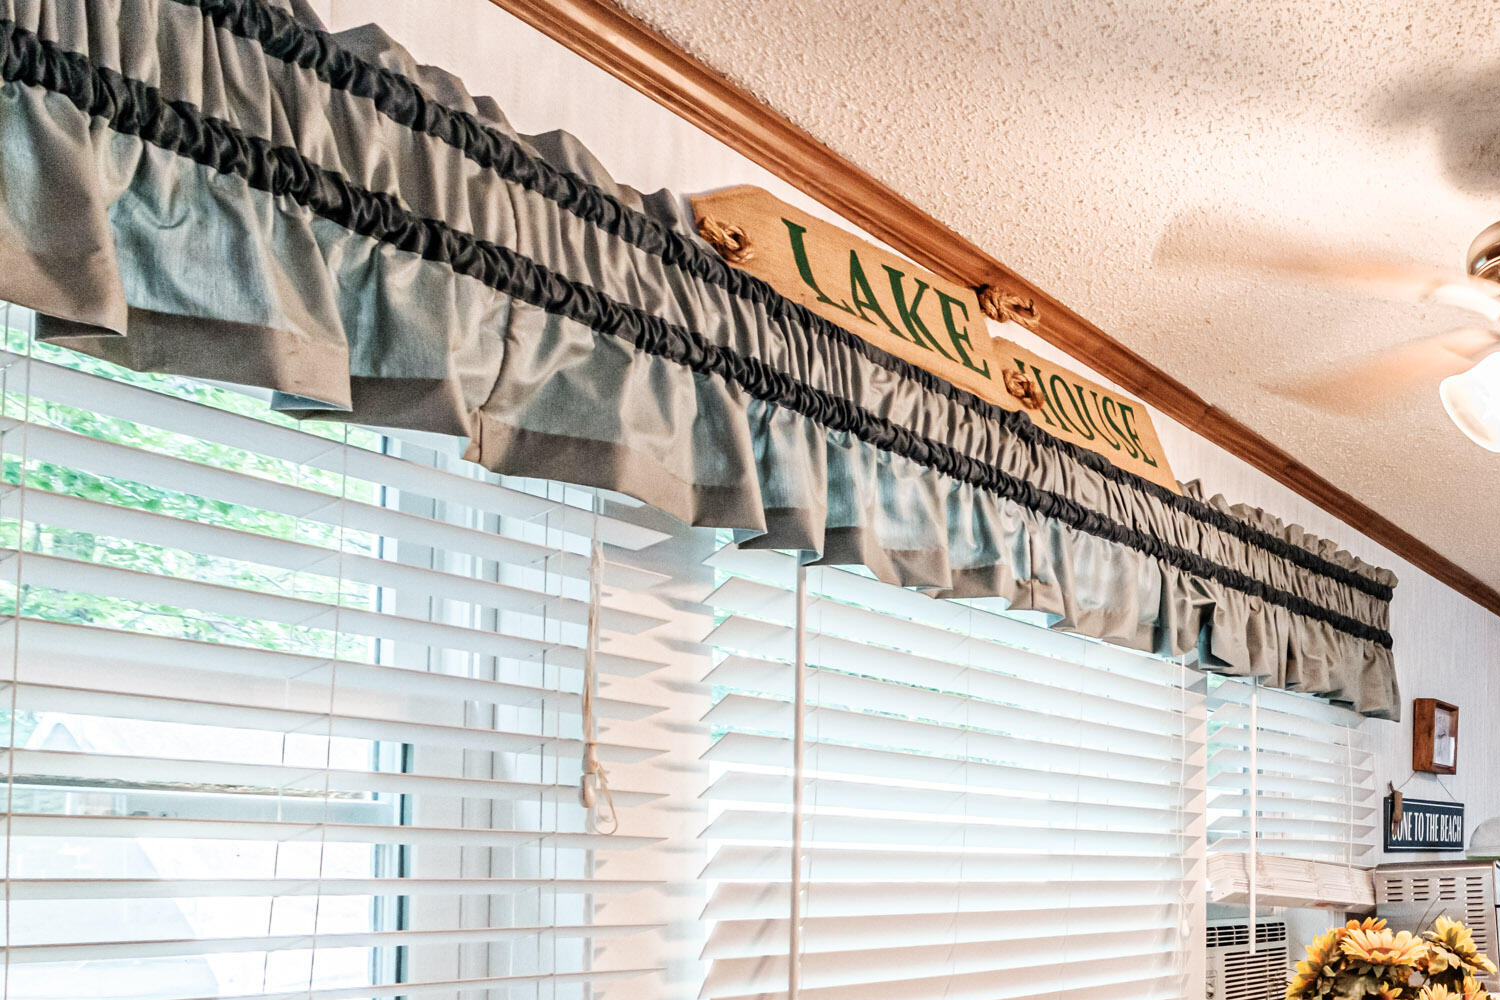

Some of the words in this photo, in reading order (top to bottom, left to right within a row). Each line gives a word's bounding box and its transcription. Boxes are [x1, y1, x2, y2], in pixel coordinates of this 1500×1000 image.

[780, 217, 992, 380] LAKE
[1012, 357, 1159, 469] HOUSE
[1414, 811, 1425, 842] TO
[1425, 812, 1439, 843] THE
[1440, 814, 1462, 842] BEACH
